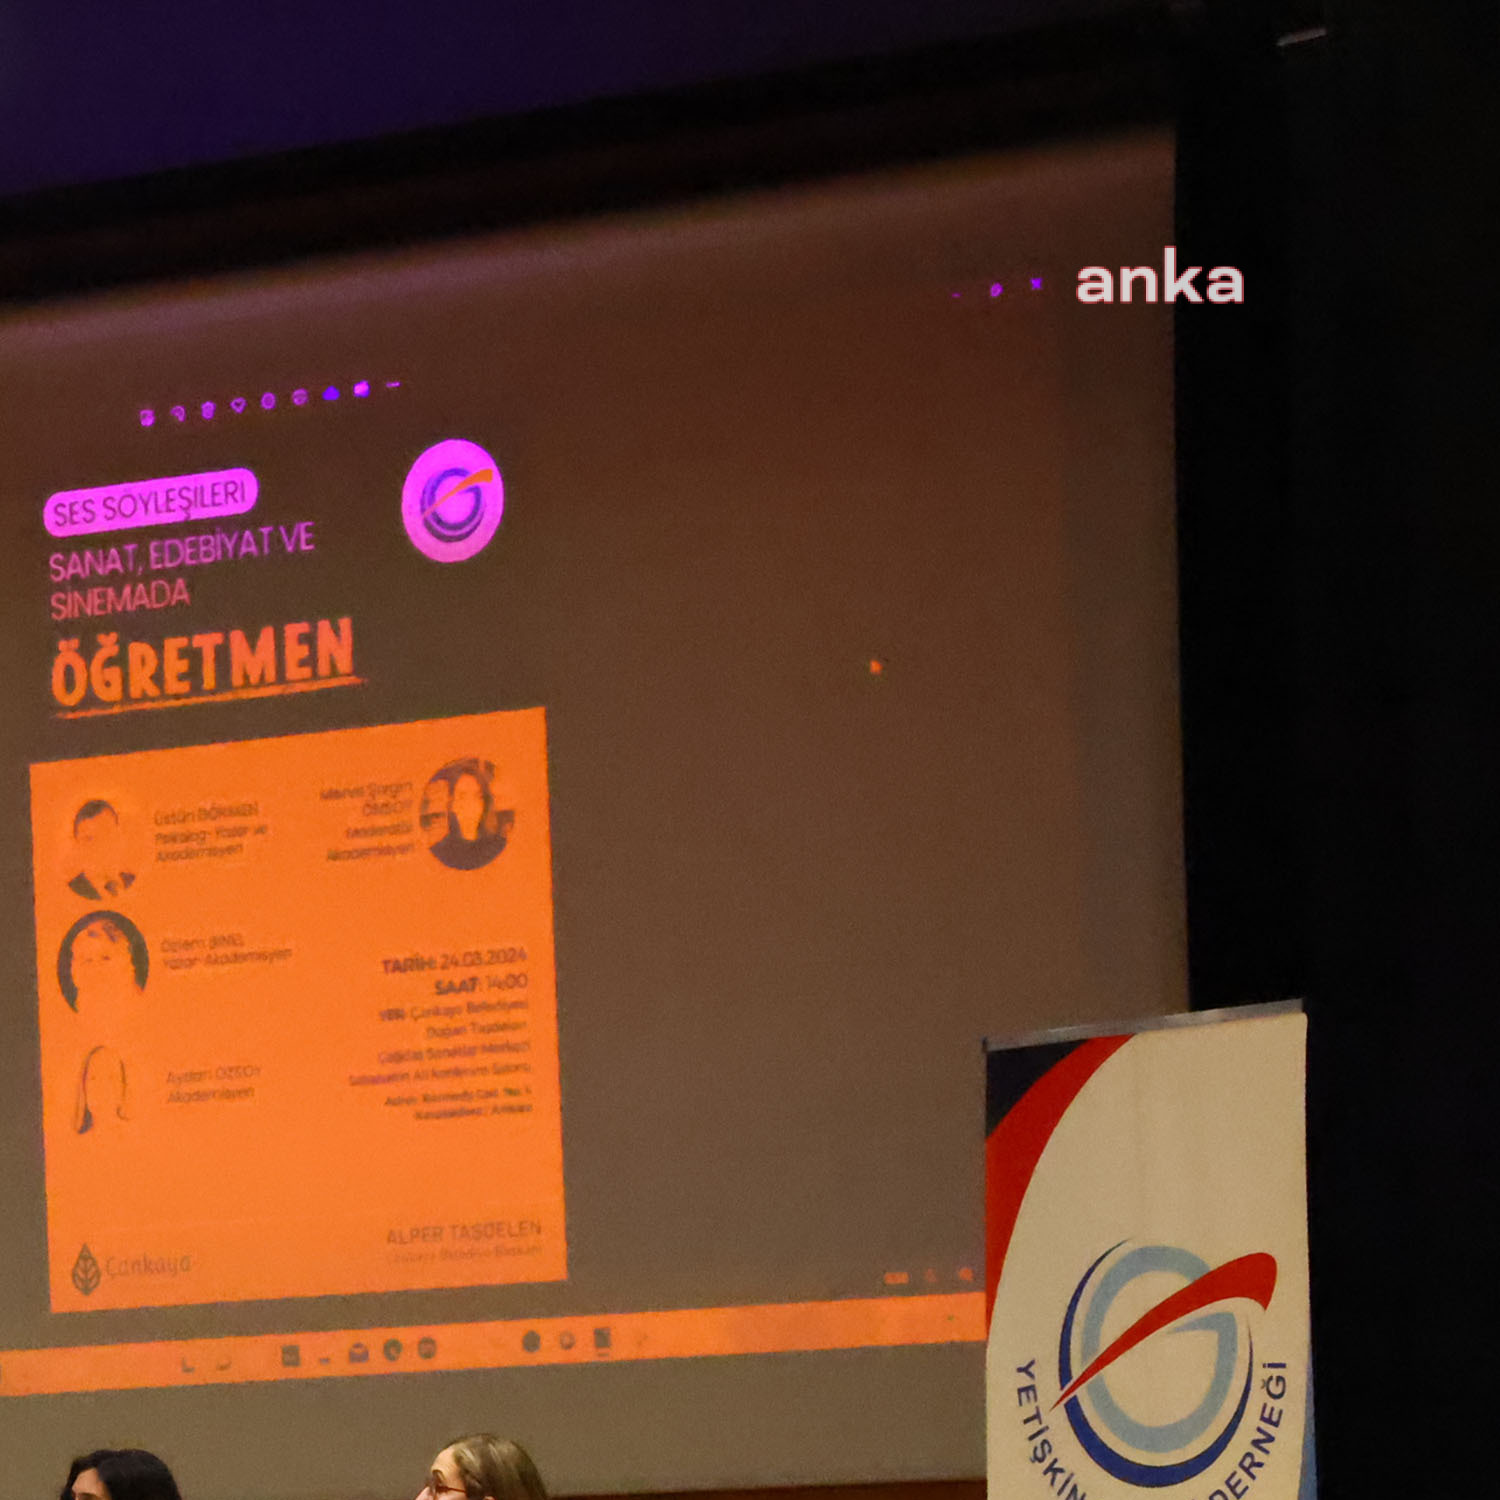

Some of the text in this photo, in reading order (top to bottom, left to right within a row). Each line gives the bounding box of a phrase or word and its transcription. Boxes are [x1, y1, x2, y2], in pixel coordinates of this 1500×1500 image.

[53, 498, 96, 527] SES
[50, 543, 145, 583] SANAT,
[279, 521, 315, 553] VE
[51, 617, 354, 708] ÖĞRETMEN
